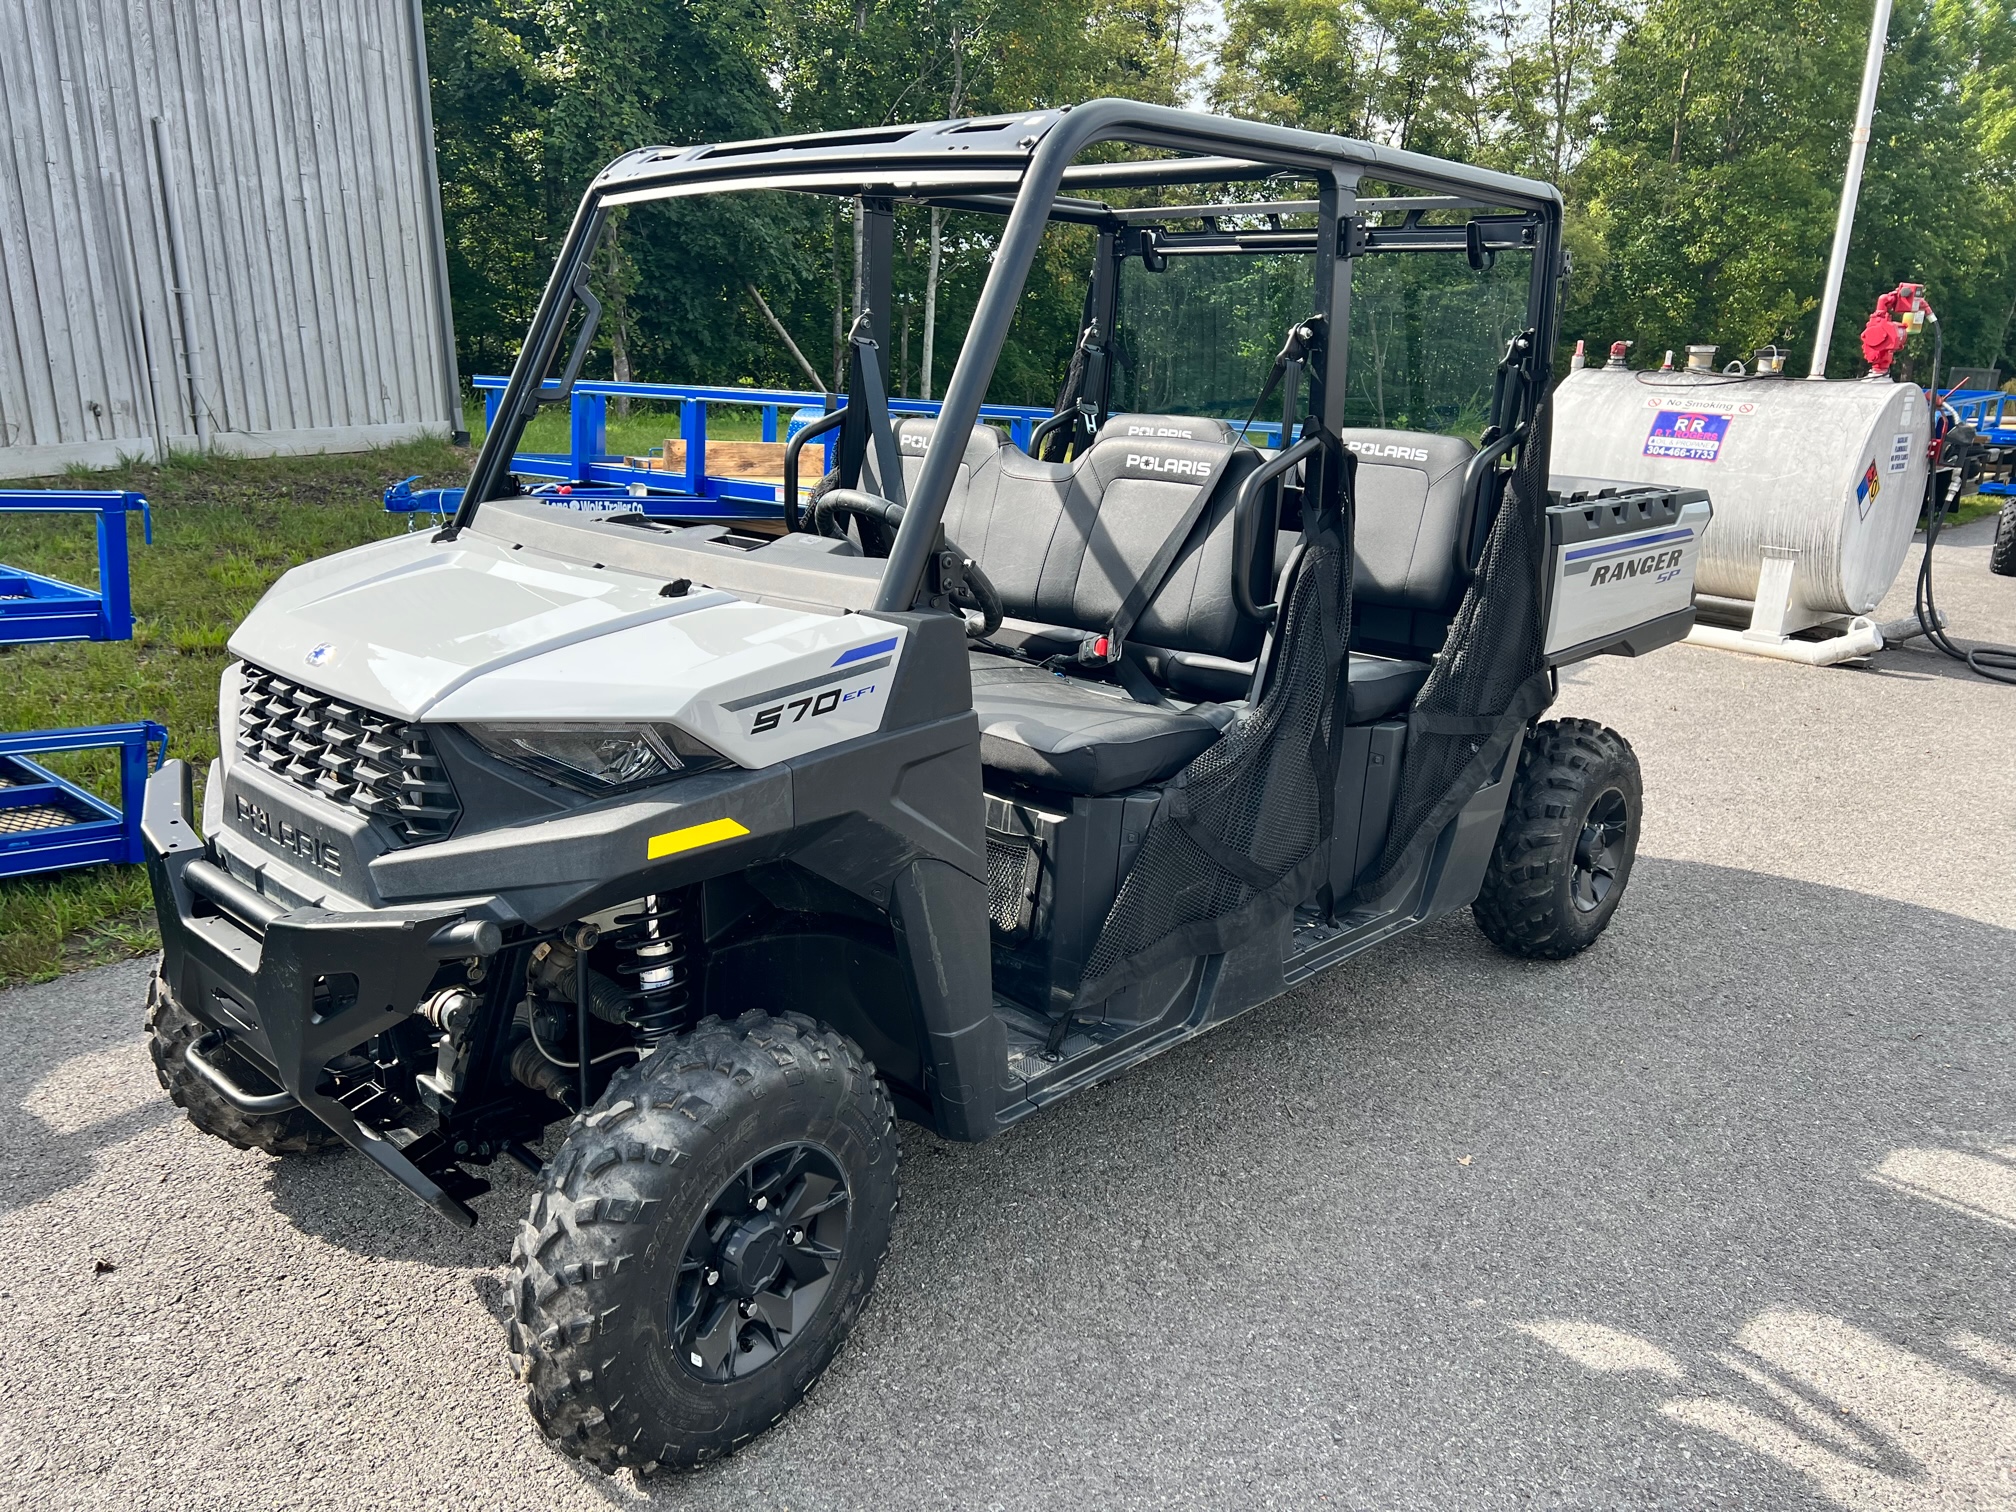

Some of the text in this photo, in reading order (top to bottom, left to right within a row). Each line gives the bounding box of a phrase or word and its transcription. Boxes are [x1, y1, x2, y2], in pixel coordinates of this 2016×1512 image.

[1685, 401, 1734, 411] Smoking
[1128, 426, 1192, 439] POLARIS
[1675, 431, 1718, 440] ROGERS
[1656, 437, 1669, 445] OIL
[1675, 440, 1711, 448] PROPANE
[1348, 441, 1429, 462] POLARIS
[1647, 446, 1715, 459] 304-466-1733
[1126, 454, 1212, 477] POLARIS
[580, 501, 602, 511] Wolf
[604, 501, 632, 511] Trailer
[632, 502, 645, 514] Co.
[1590, 549, 1683, 587] RANGER
[1655, 569, 1681, 584] SP
[750, 685, 875, 735] 570 EFI
[235, 794, 342, 877] POLARIS
